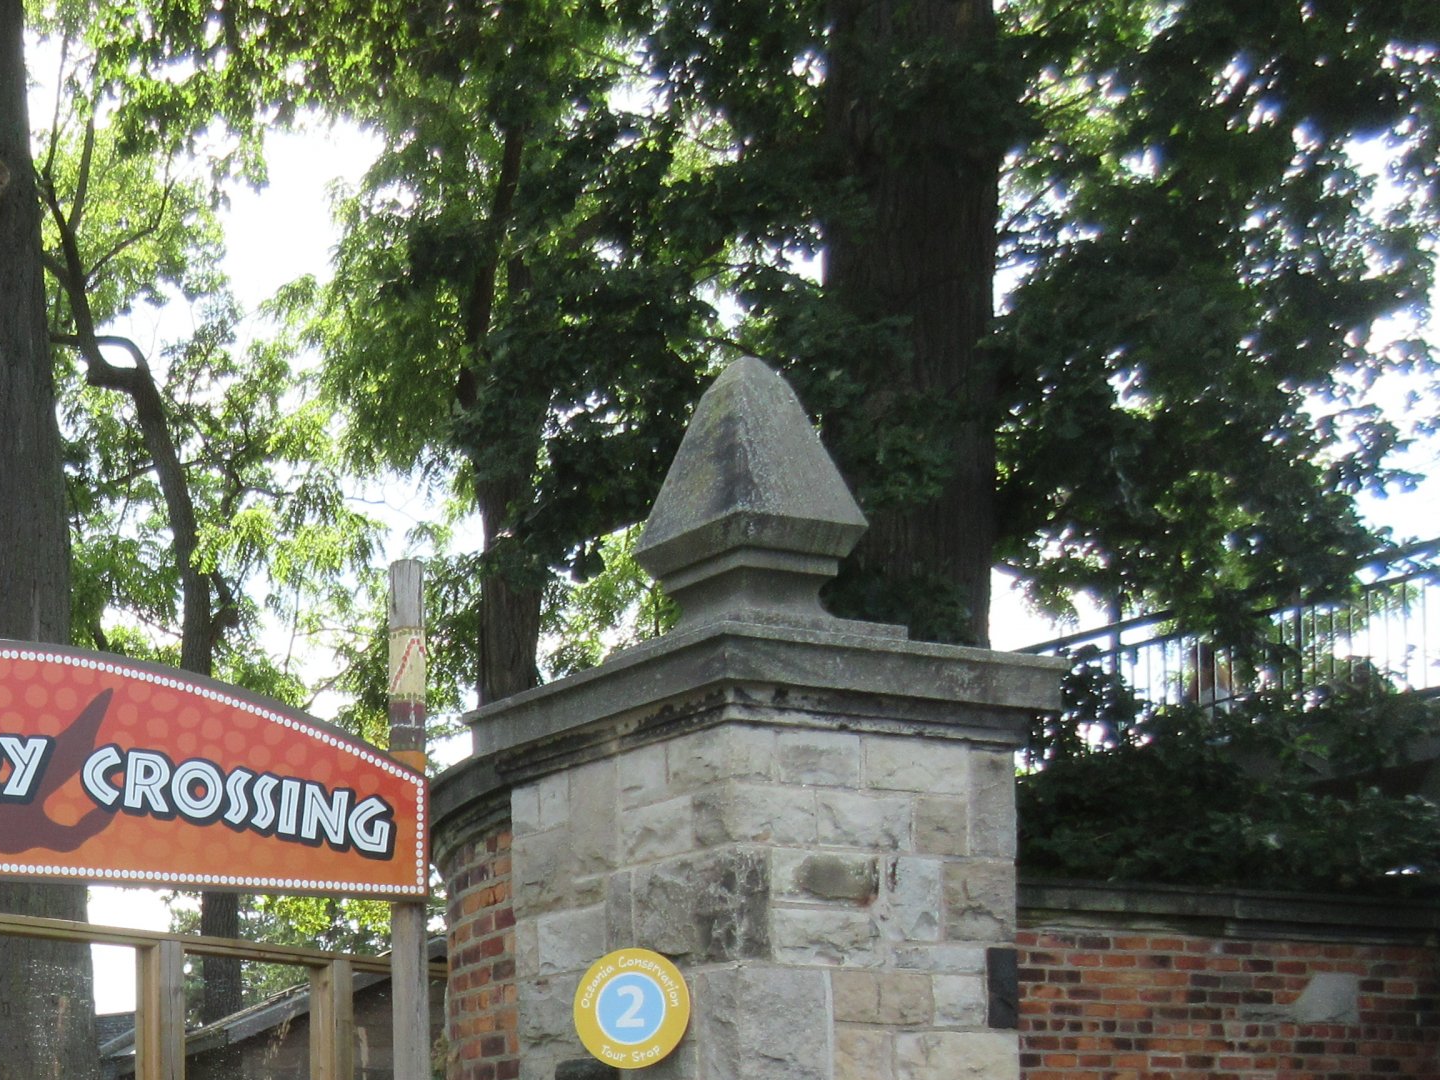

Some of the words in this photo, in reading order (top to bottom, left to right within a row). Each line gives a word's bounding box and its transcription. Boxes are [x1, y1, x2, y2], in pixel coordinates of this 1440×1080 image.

[83, 745, 395, 855] CROSSING
[581, 965, 615, 1009] Oceania
[618, 956, 680, 1008] Conservation
[615, 985, 645, 1028] 2
[601, 1045, 627, 1062] Tour
[632, 1046, 661, 1062] Stop
